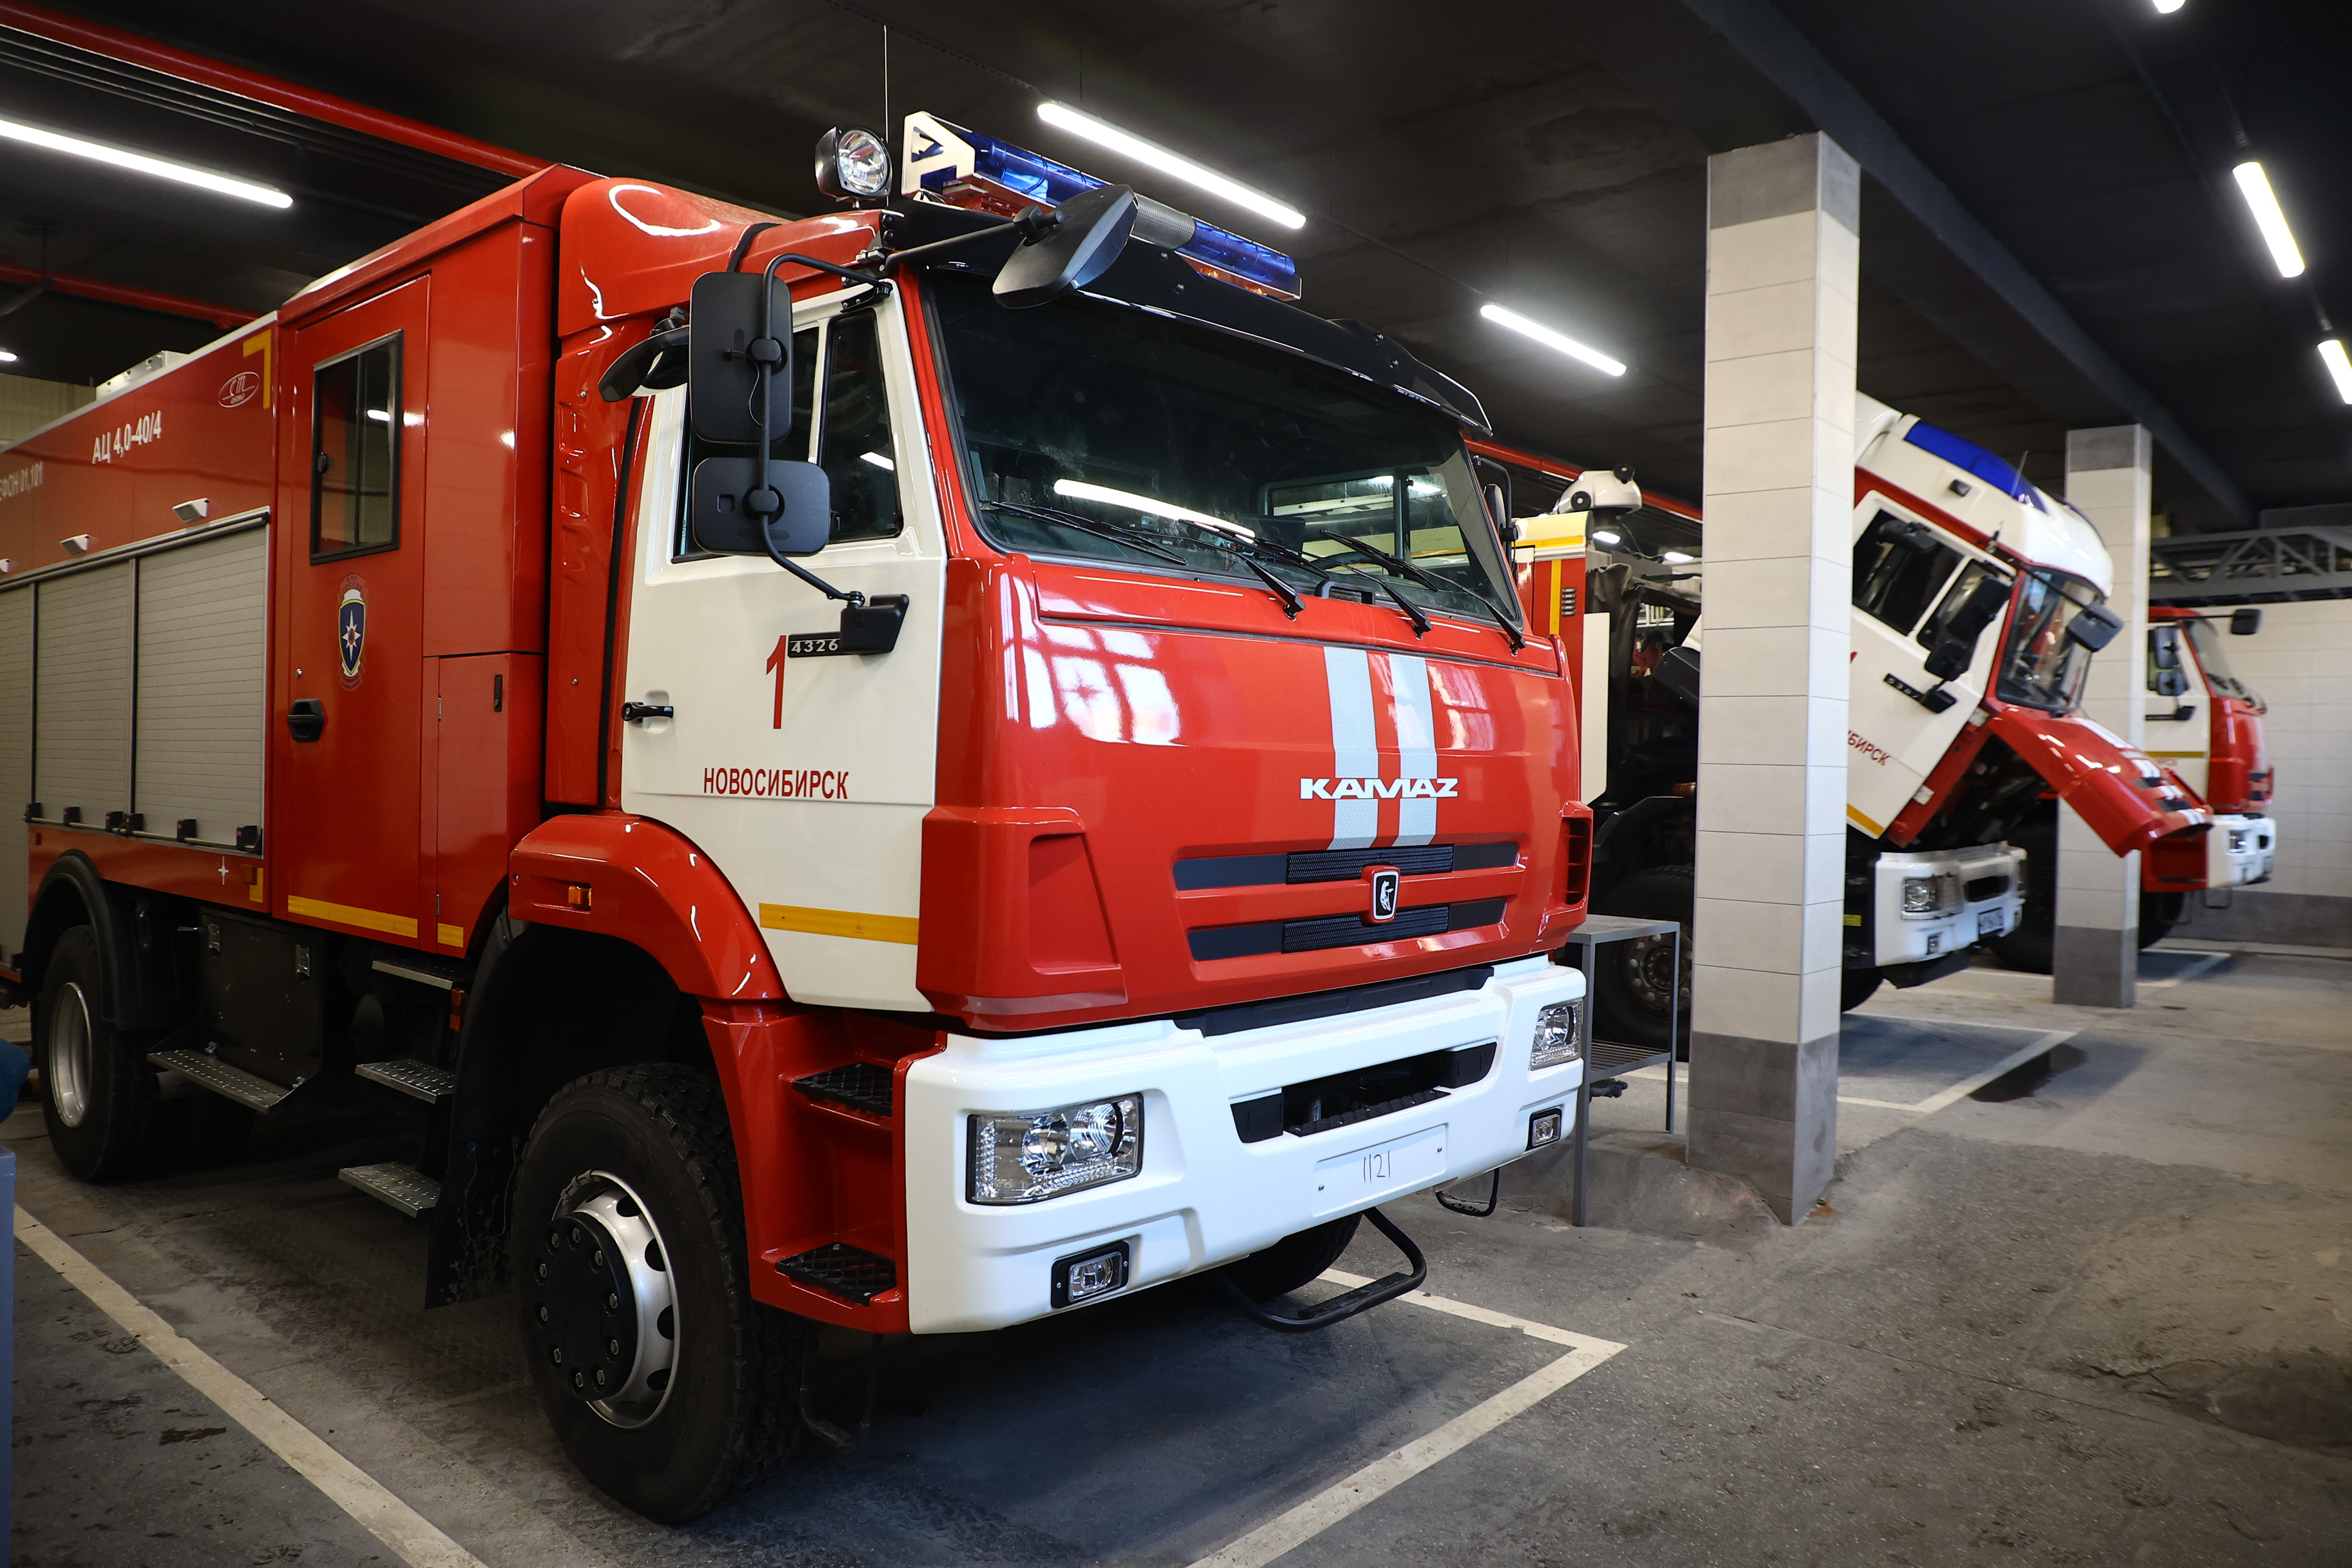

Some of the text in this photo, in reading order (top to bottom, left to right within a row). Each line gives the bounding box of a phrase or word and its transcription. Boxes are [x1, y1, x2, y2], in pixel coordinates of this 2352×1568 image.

[92, 409, 162, 464] АЦ 4,0-40/4
[791, 638, 839, 653] 4326
[766, 634, 787, 730] 1
[1848, 730, 1892, 766] БИРСК
[703, 767, 849, 799] НОВОСИБИРСК
[1300, 778, 1459, 799] KAMAZ
[1363, 1150, 1391, 1184] 1121
